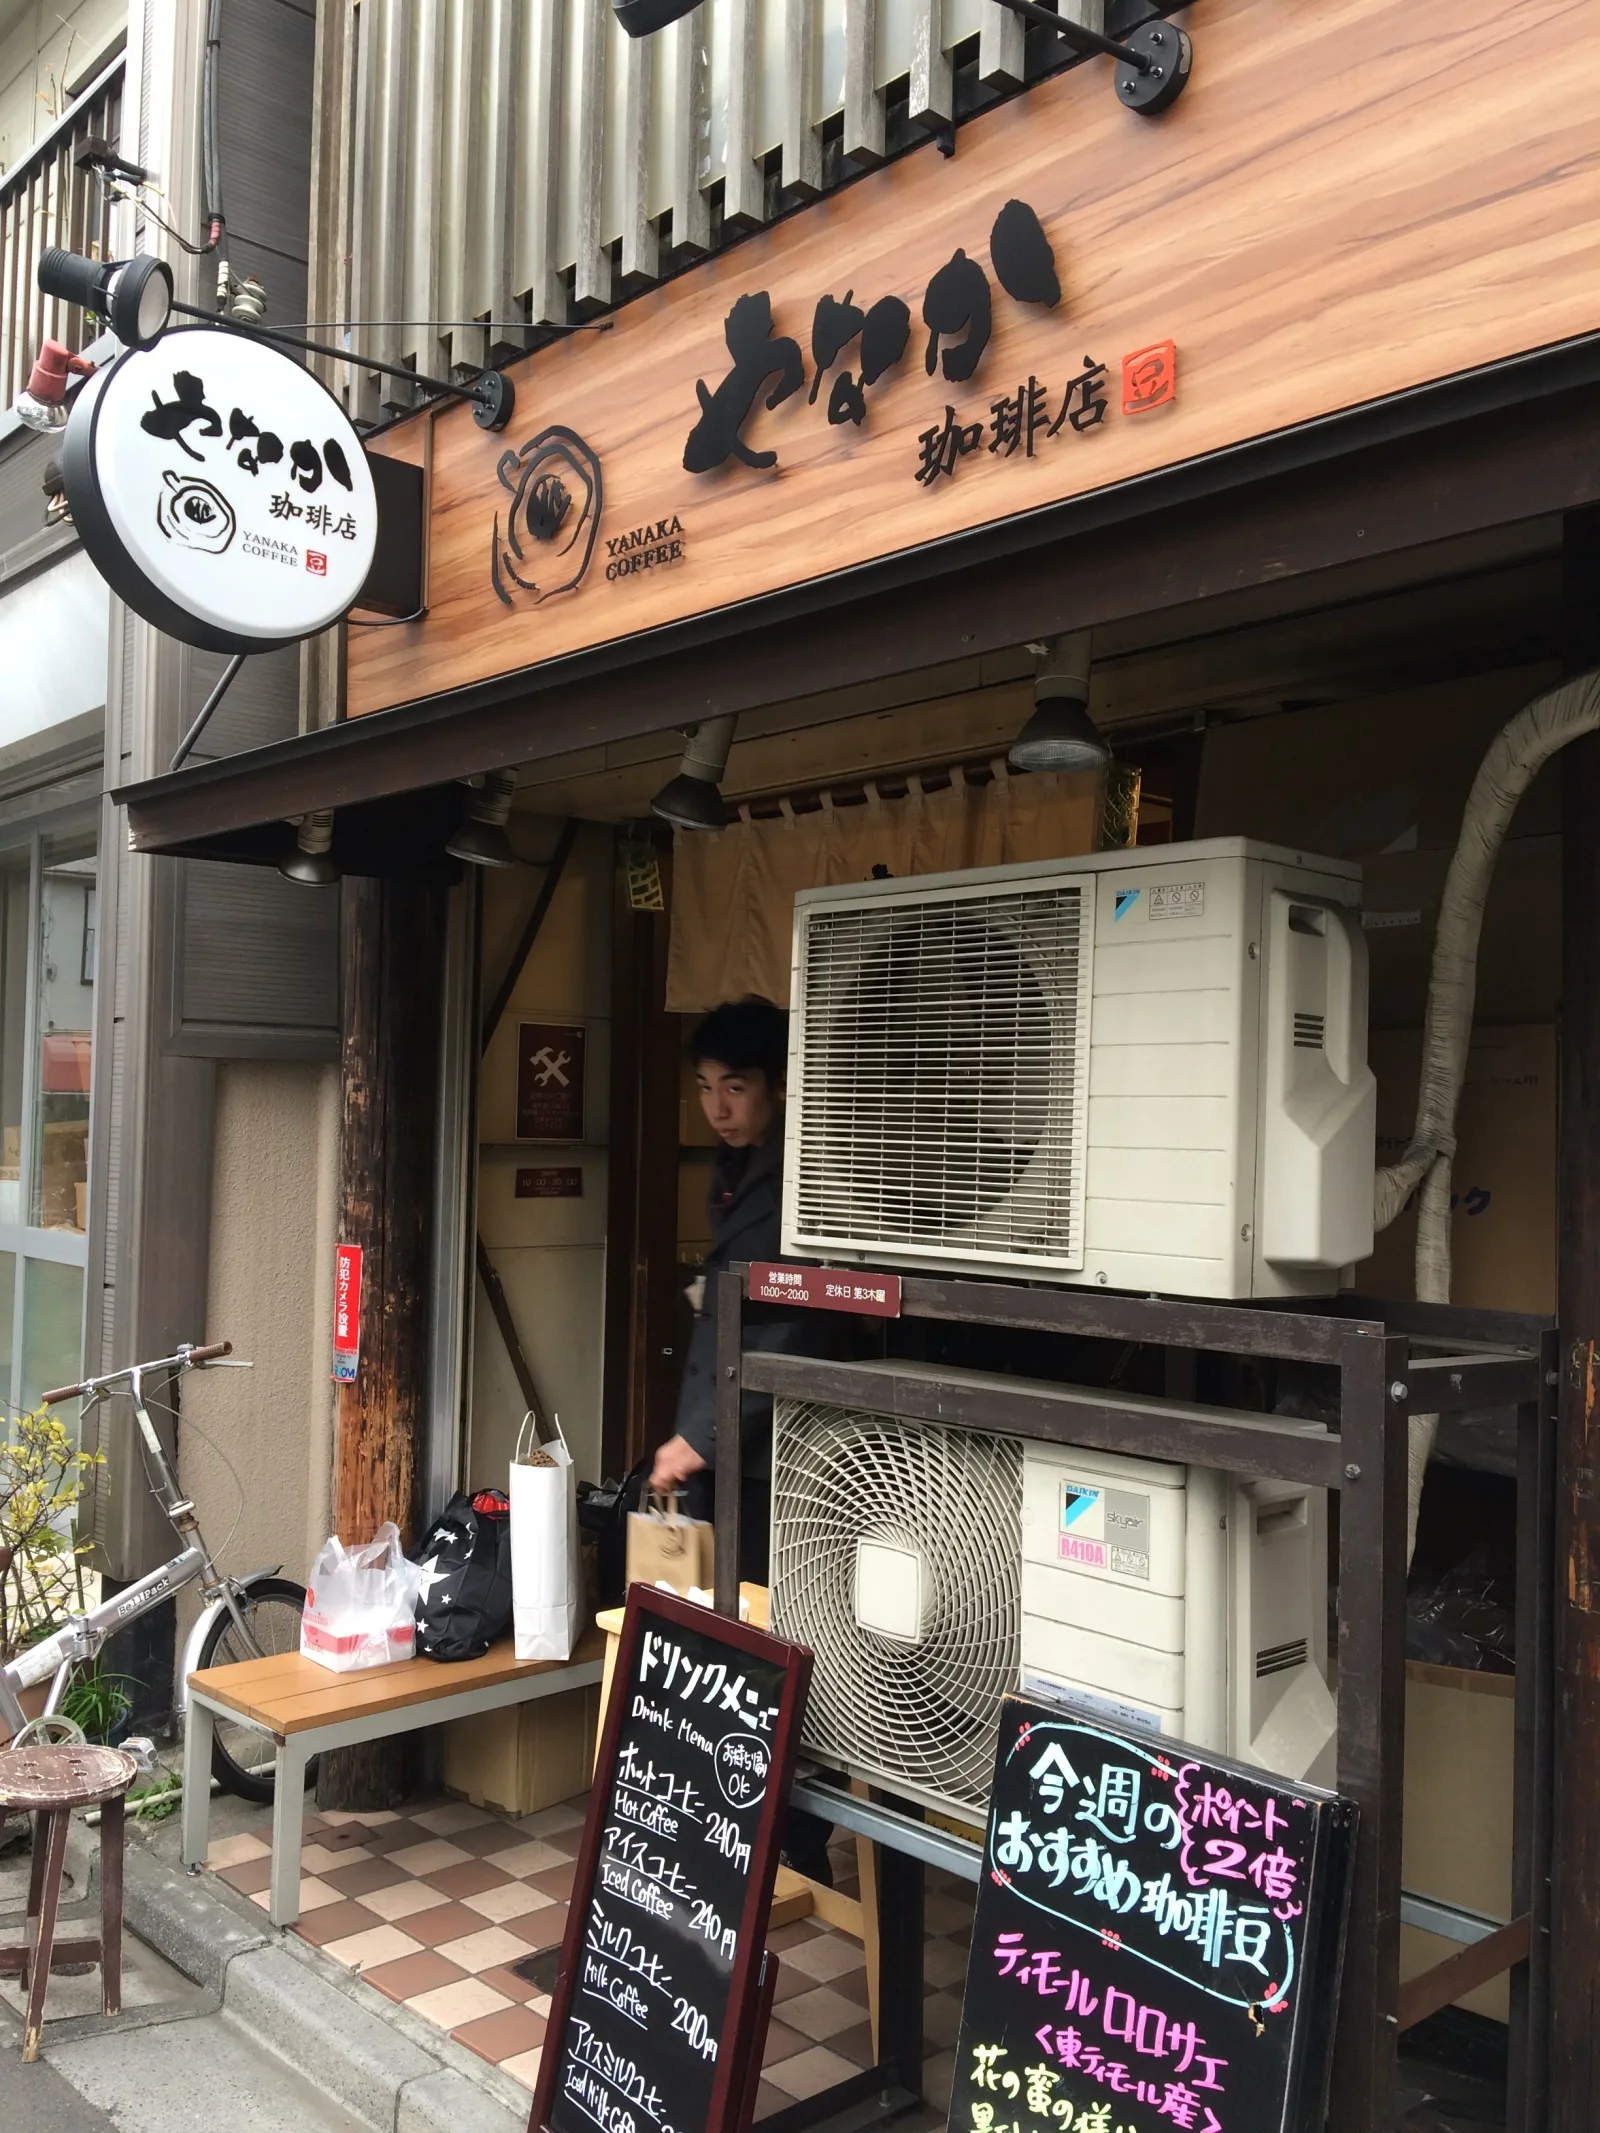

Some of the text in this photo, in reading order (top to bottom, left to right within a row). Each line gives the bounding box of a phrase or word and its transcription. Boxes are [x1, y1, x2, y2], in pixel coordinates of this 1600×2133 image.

[683, 199, 1061, 473] やなか
[140, 370, 354, 493] やなか
[914, 355, 1108, 487] 珈琲店
[242, 530, 298, 555] YANAKA
[268, 491, 357, 540] 珈琲店
[605, 515, 685, 557] YANAKA
[242, 543, 298, 567] COFFEE
[605, 540, 683, 581] COFFEE
[337, 1256, 351, 1338] 防犯カメラ設置
[768, 1271, 803, 1286] 営業時間
[825, 1284, 886, 1303] 定休日 第3木曜
[1066, 1485, 1100, 1498] DAIKIN
[1106, 1511, 1143, 1529] skyair
[1060, 1536, 1104, 1566] R410A
[639, 1631, 779, 1731] ドリンクメニュー
[631, 1695, 674, 1732] Drink
[615, 1790, 679, 1836] Hot Coffee
[619, 1741, 751, 1875] ホットコーヒー 240円
[1029, 1742, 1182, 1851] 今週の
[1191, 1782, 1289, 1841] ポイント
[601, 1863, 674, 1919] Iced Coffee
[604, 1827, 737, 1961] アイスコーヒー 240円
[997, 1811, 1270, 1977] おすすめ珈琲豆
[1202, 1838, 1298, 1900] 2倍
[586, 1898, 673, 1987] ミルクコーヒー
[583, 1955, 649, 2020] Milk Coffee
[565, 2064, 589, 2098] Iced
